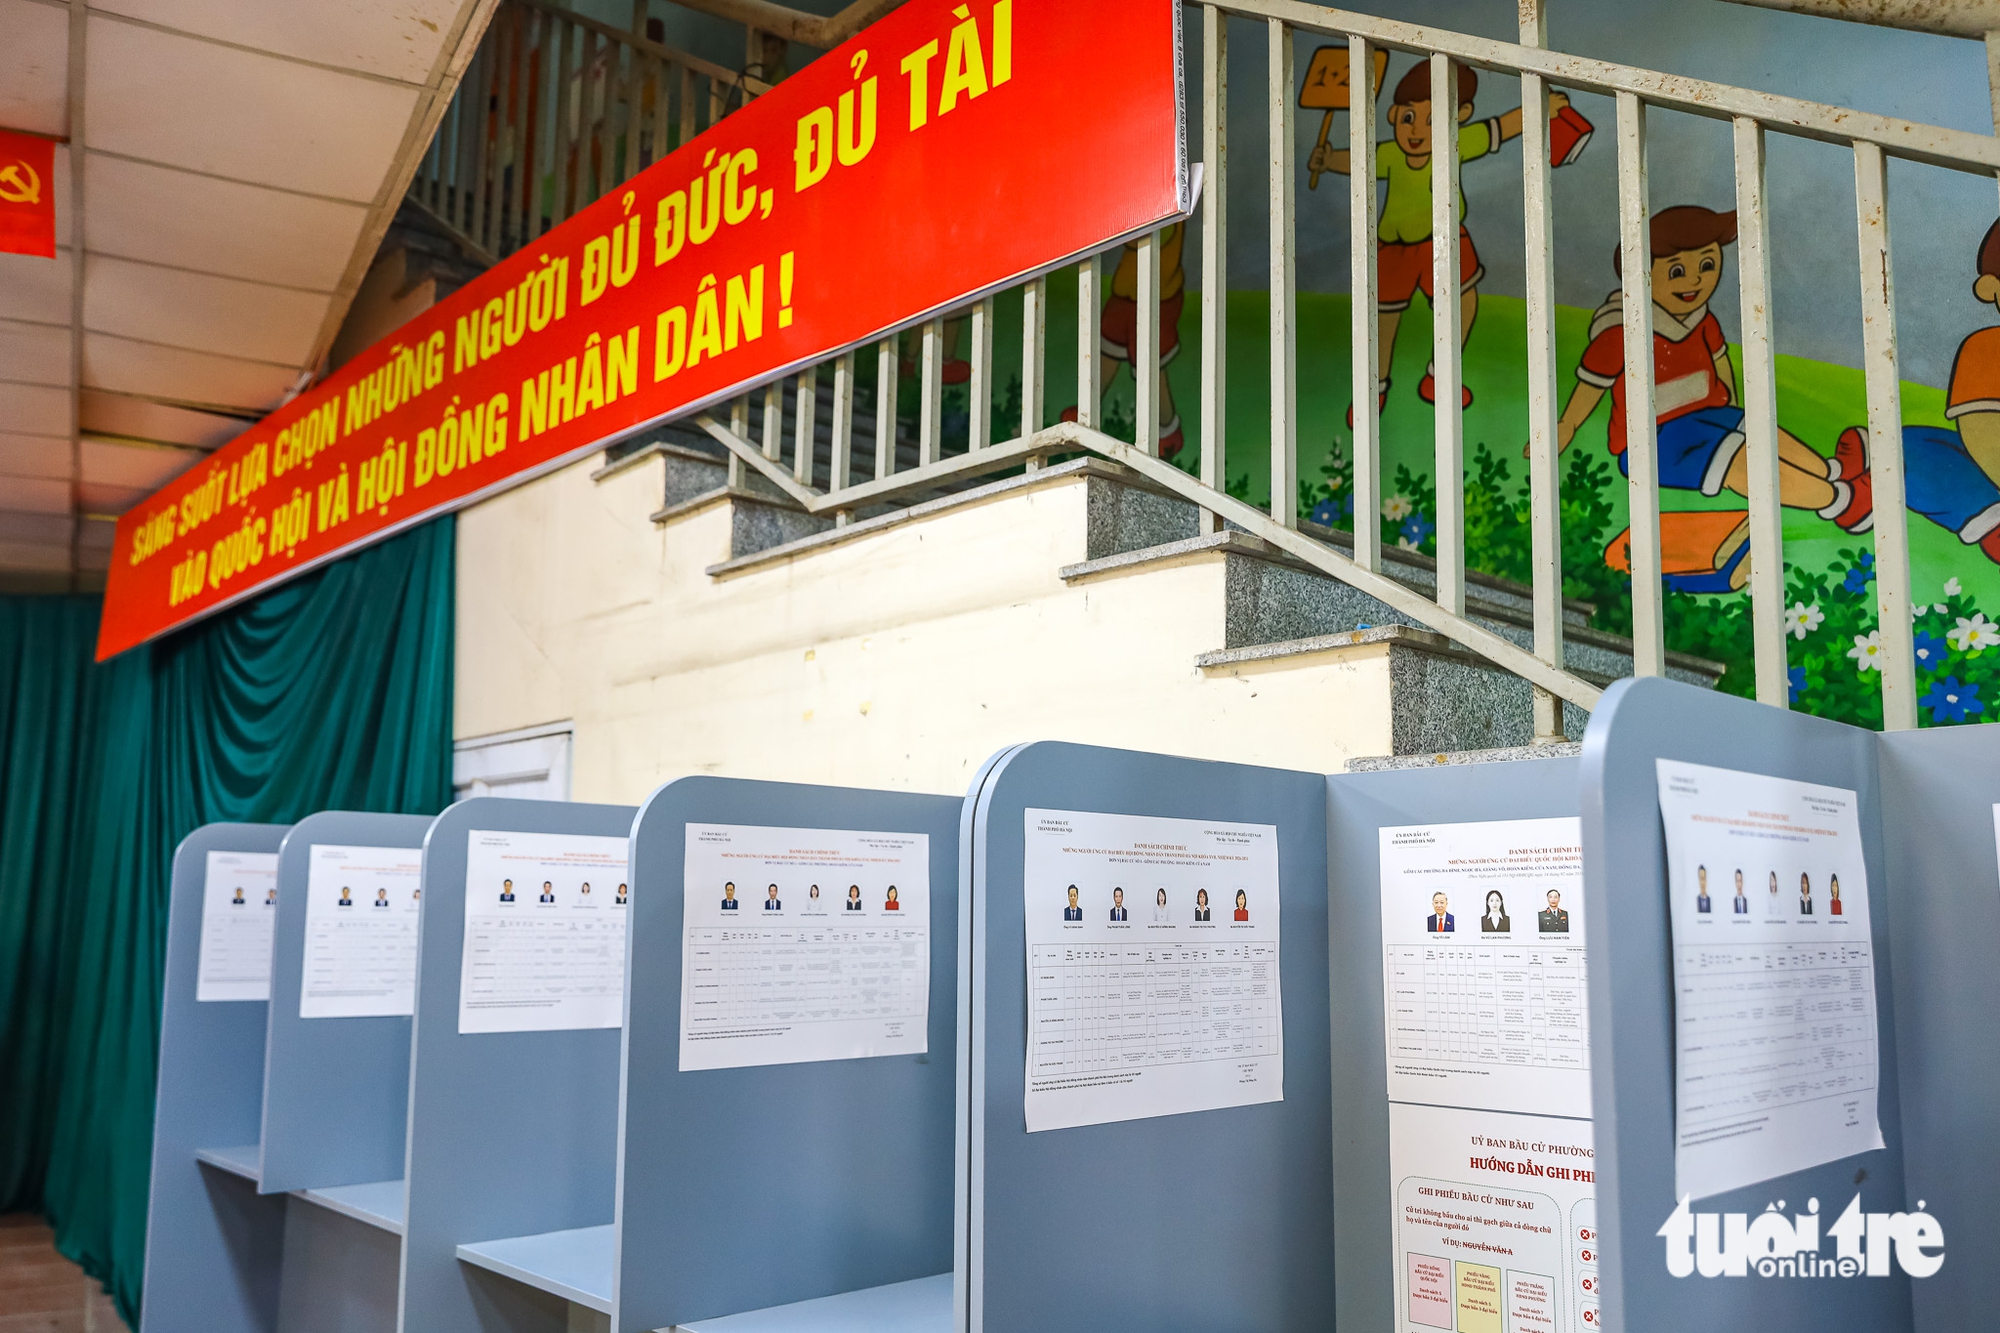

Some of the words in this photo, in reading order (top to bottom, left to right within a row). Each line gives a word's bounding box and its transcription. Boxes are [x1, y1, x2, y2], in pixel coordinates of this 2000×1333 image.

[130, 505, 177, 566] SÁNG
[177, 460, 228, 537] SUỐT
[228, 443, 268, 507] LỰA
[272, 395, 340, 477] CHỌN
[344, 330, 445, 436] NHỮNG
[454, 253, 569, 375] NGƯỜI
[581, 190, 641, 307] ĐỦ
[654, 147, 774, 267] ĐỨC,
[794, 49, 878, 193] ĐỦ
[900, 0, 1013, 132] TÀI
[169, 550, 207, 607] VÀO
[208, 506, 266, 589] QUỐC
[269, 487, 312, 558] HỘI
[317, 462, 349, 534] VÀ
[356, 437, 407, 516] HỘI
[413, 395, 509, 488] ĐỒNG
[518, 325, 640, 442] NHÂN
[654, 263, 765, 383] DÂN
[778, 251, 794, 329] !
[1487, 1138, 1506, 1148] BAN
[1509, 1139, 1529, 1151] BẦU
[1531, 1141, 1546, 1153] CỬ
[1549, 1145, 1594, 1158] PHƯỜNG
[1470, 1156, 1515, 1174] HƯỚNG
[1517, 1159, 1544, 1177] DẪN
[1546, 1166, 1570, 1180] GHI
[1418, 1186, 1433, 1196] GHI
[1435, 1189, 1460, 1200] PHIẾU
[1462, 1191, 1479, 1202] BẦU
[1481, 1194, 1493, 1204] CỬ
[1495, 1197, 1515, 1207] NHƯ
[1517, 1200, 1534, 1210] SAU
[1414, 1216, 1422, 1224] và
[1454, 1213, 1466, 1221] cho
[1442, 1237, 1450, 1246] VÍ
